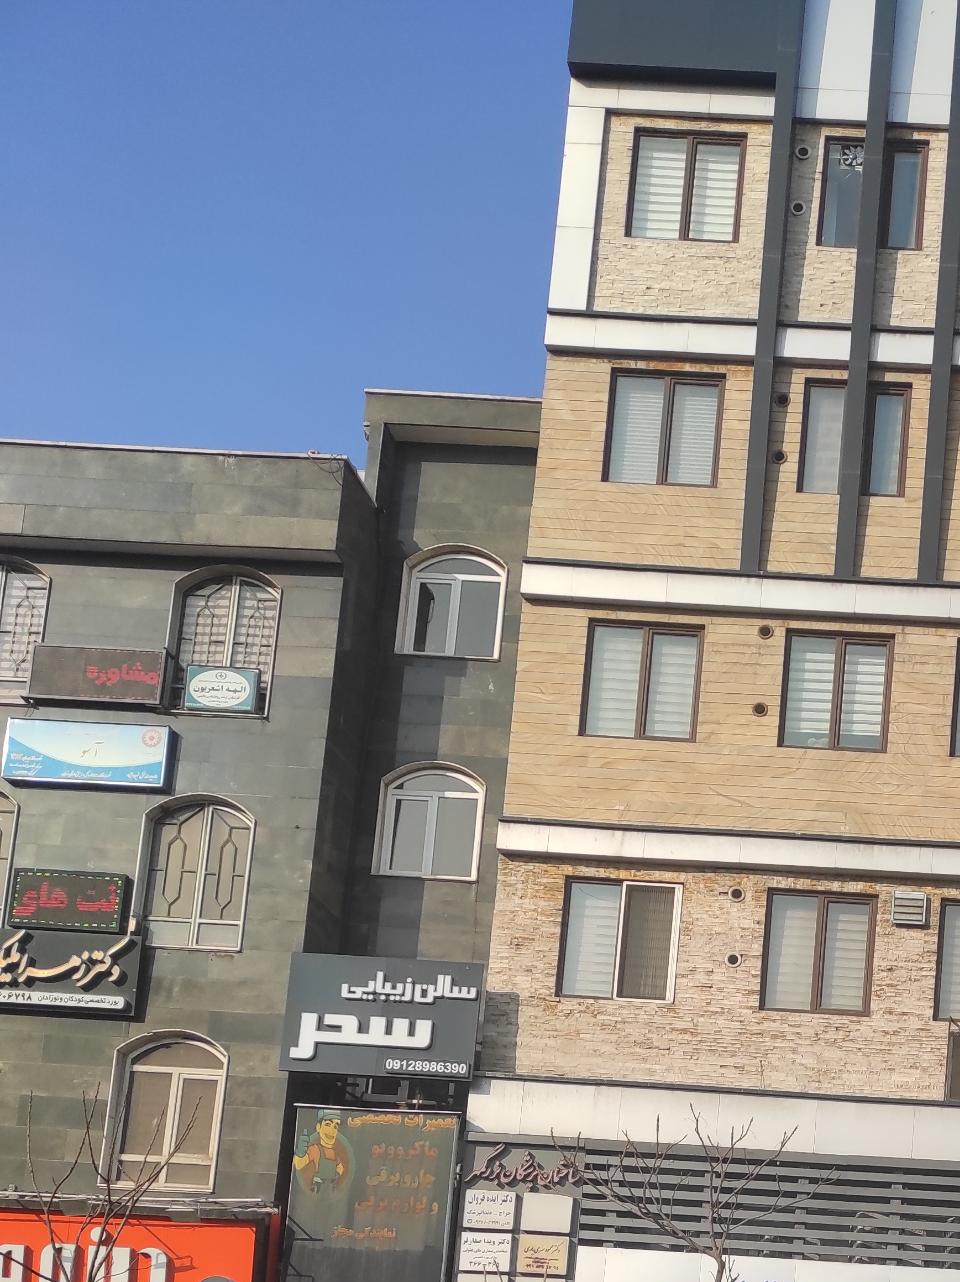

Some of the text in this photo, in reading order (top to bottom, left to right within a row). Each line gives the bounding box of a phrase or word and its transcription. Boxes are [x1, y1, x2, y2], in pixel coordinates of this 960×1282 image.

[341, 971, 477, 1003] سالن زیبایی
[289, 1012, 434, 1060] سحر
[385, 1058, 467, 1073] 09128986390
